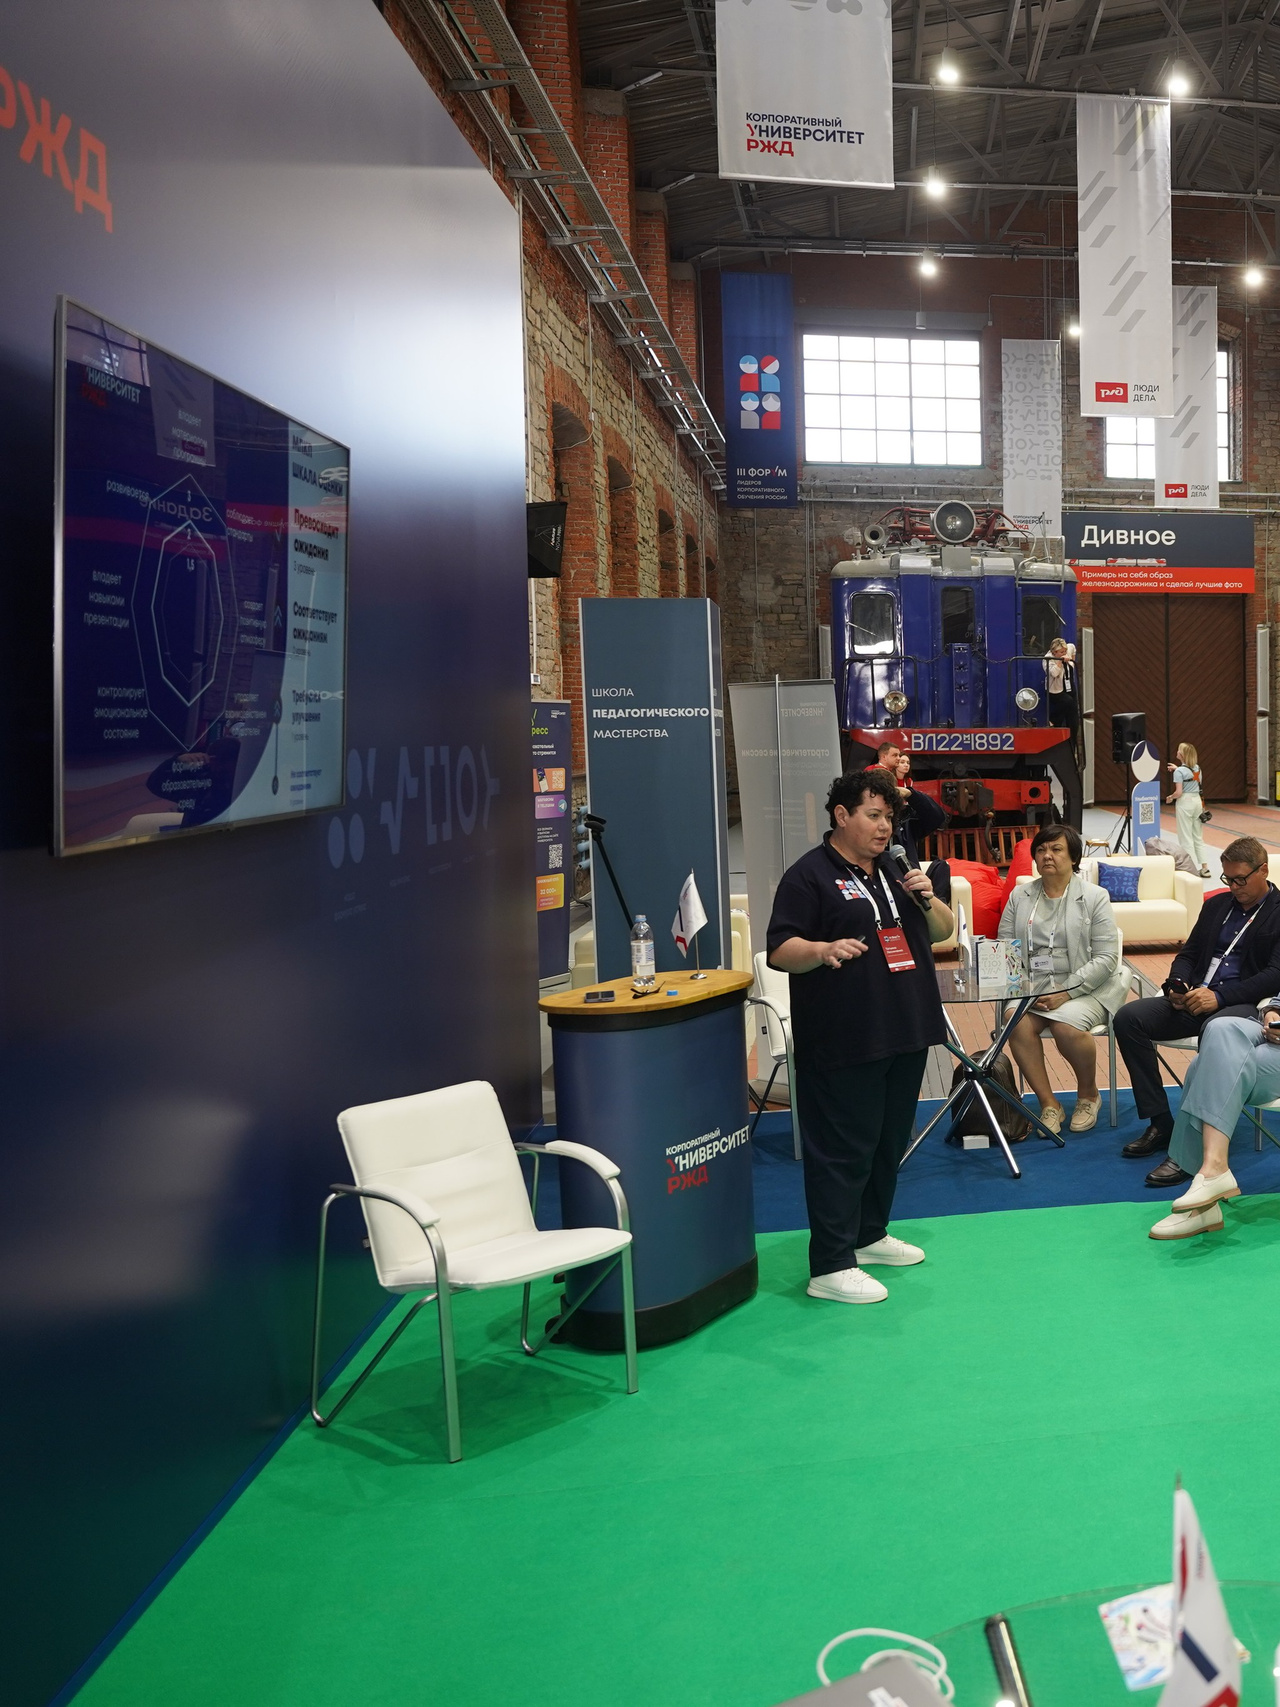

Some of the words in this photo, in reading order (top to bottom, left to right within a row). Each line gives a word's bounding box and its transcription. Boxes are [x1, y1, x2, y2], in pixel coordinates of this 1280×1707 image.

[746, 112, 842, 127] КОРПОРАТИВНЫЙ
[746, 123, 864, 144] УНИВЕРСИТЕТ
[746, 138, 794, 157] РЖД
[1133, 384, 1160, 393] ЛЮДИ
[1133, 394, 1157, 402] ДЕЛА
[292, 462, 318, 487] ШКАЛА
[748, 465, 788, 477] ФОРУМ
[1081, 525, 1176, 547] Дивное
[294, 538, 329, 561] ожидания
[92, 570, 122, 585] владеет
[1082, 571, 1117, 580] Примерь
[1130, 570, 1148, 579] себя
[1149, 570, 1174, 579] образ
[1082, 581, 1158, 589] железнодорожника
[1165, 579, 1194, 589] сделай
[1224, 580, 1243, 589] фото
[83, 612, 130, 629] презентации
[293, 601, 338, 625] Соответствует
[97, 686, 146, 700] контролирует
[592, 688, 634, 697] ШКОЛА
[593, 708, 709, 719] ПЕДАГОГИЧЕСКОГО
[103, 728, 140, 739] состояние
[593, 729, 669, 739] МАСТЕРСТВА
[666, 1127, 721, 1156] КОРПОРАТИВНЫЙ
[666, 1125, 750, 1174] УНИВЕРСИТЕТ
[667, 1165, 708, 1194] РЖД
